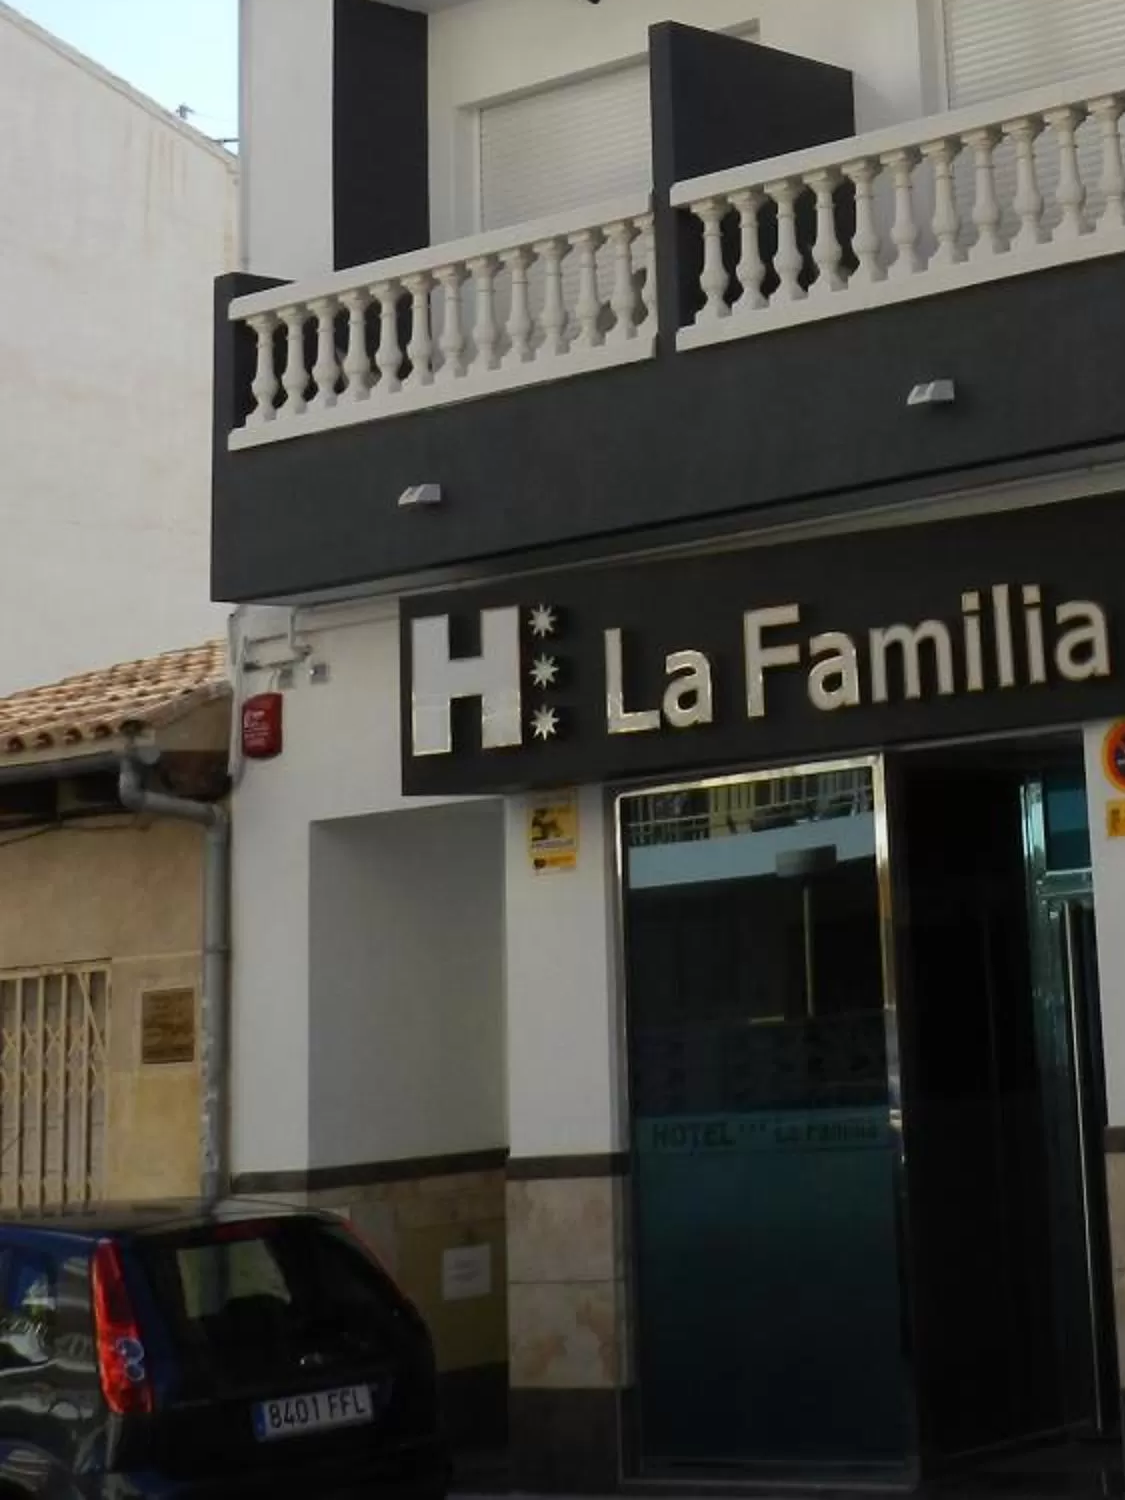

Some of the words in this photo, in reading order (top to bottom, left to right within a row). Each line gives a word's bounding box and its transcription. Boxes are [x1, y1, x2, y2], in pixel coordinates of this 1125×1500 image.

[411, 605, 522, 756] H
[604, 627, 713, 735] La
[743, 584, 1111, 719] Familia
[652, 1121, 736, 1148] HOTEL
[269, 1395, 320, 1428] 8401
[328, 1388, 366, 1418] FFL
